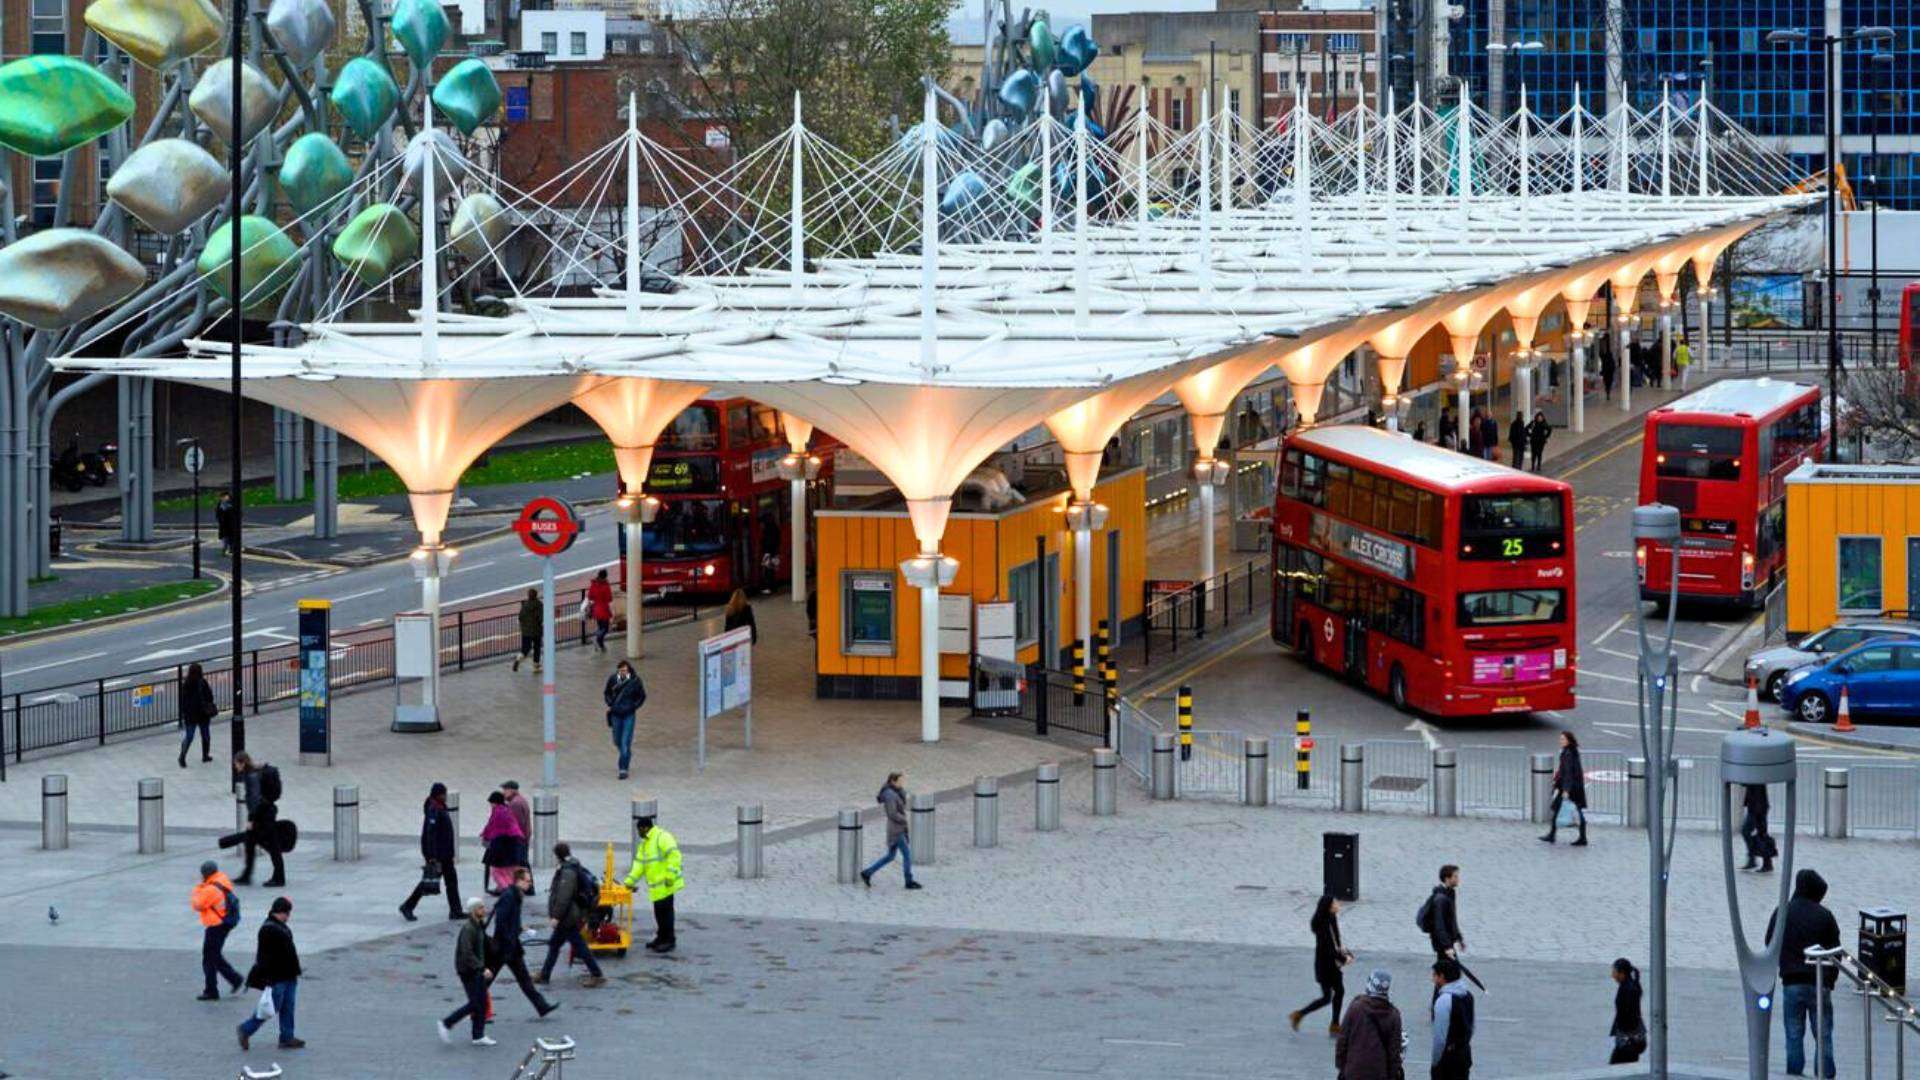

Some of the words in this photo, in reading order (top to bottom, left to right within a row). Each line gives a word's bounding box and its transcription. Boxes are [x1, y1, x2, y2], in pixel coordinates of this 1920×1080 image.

[674, 463, 689, 475] 69
[531, 522, 558, 531] BUSES
[1351, 534, 1373, 556] ALEX
[1372, 543, 1403, 568] CROSS
[1502, 538, 1523, 556] 25
